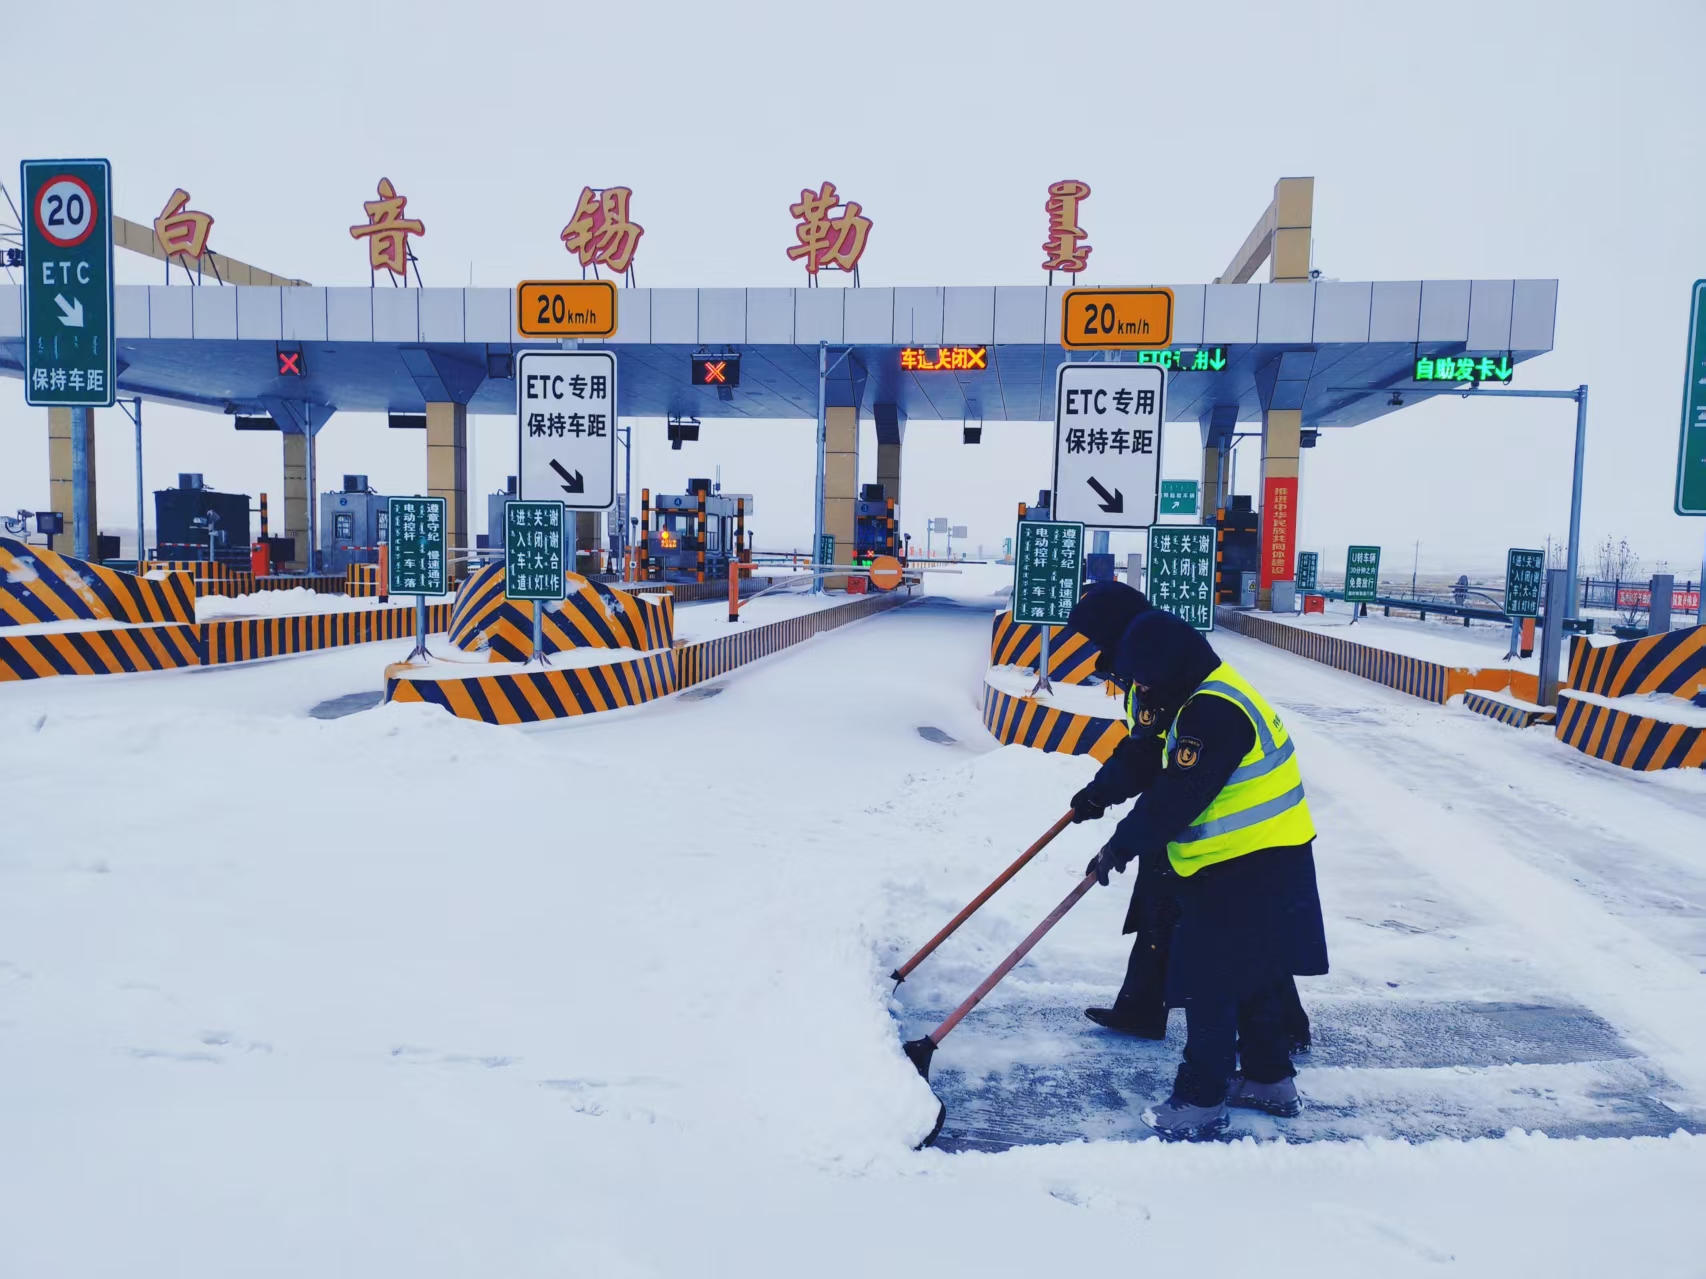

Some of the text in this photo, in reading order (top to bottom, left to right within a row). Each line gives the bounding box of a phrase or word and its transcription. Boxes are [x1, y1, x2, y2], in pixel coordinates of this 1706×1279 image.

[47, 194, 85, 227] 20
[42, 261, 91, 285] ETC
[32, 367, 104, 392] 保持车距
[1416, 356, 1496, 381] 自助发卡
[527, 412, 607, 439] 保持车距
[1065, 428, 1154, 455] 保持车距
[426, 503, 441, 588] 遵章守纪 慢速通行
[516, 509, 527, 591] 进入车道
[533, 509, 544, 591] 关闭大灯
[549, 509, 560, 592] 谢谢合作
[403, 551, 417, 588] 一车一落
[1057, 528, 1077, 619] 遵章守纪 慢速通行
[1179, 535, 1191, 623] 关闭大灯
[1197, 534, 1210, 624] 谢谢合作
[1030, 577, 1047, 618] 一车一落
